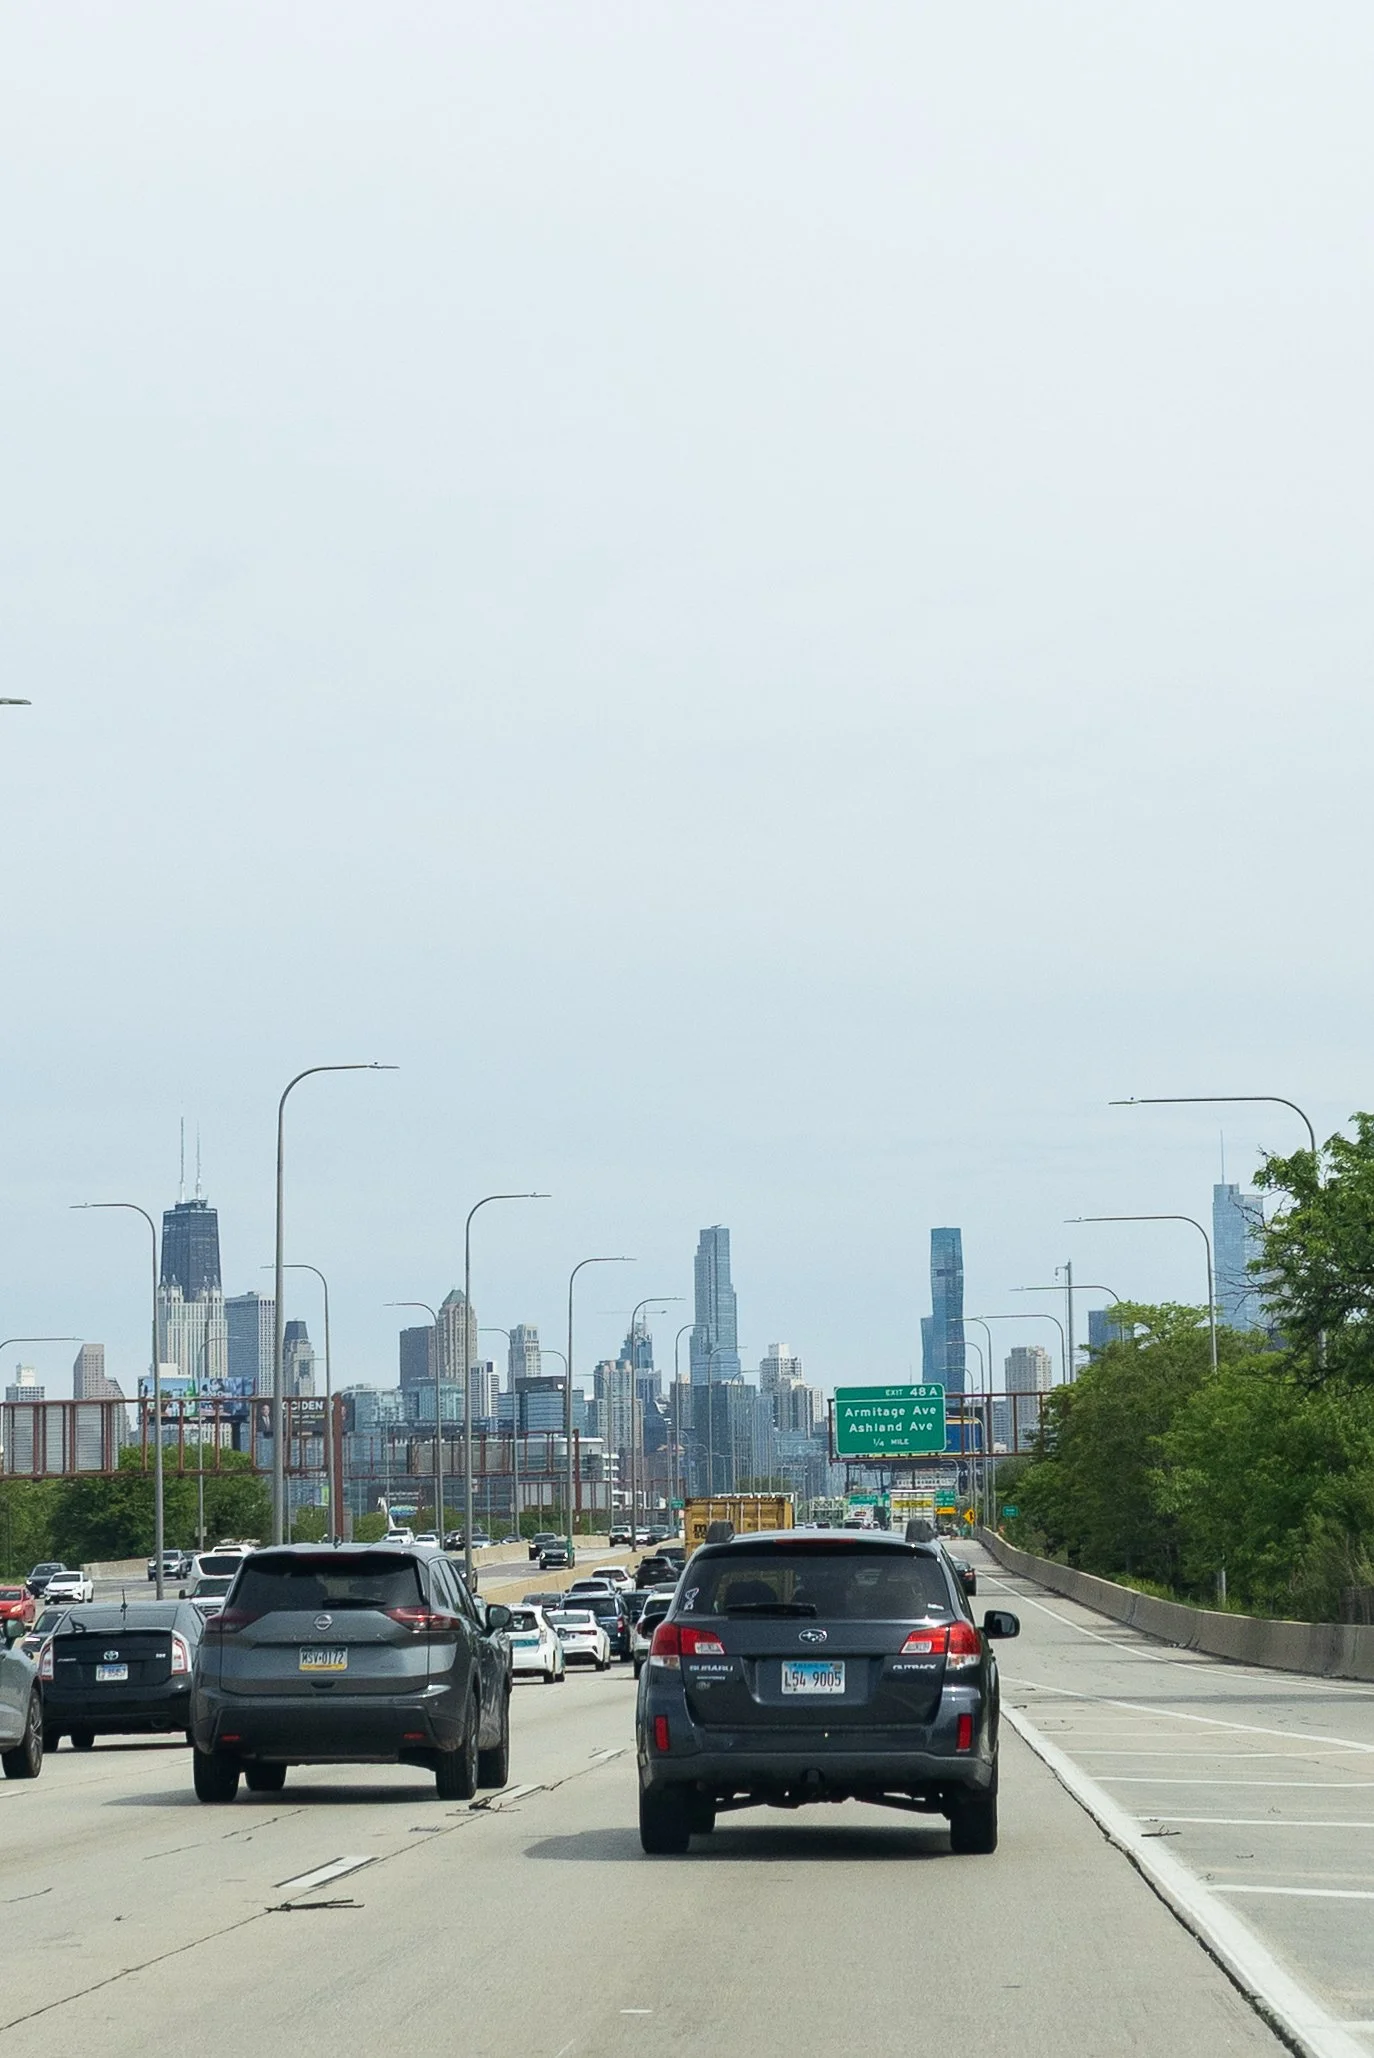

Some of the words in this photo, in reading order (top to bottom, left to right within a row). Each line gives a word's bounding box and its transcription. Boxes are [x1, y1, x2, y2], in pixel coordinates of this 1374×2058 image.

[844, 1407, 906, 1419] Armitage
[913, 1405, 937, 1415] Ave
[849, 1422, 903, 1433] Ashland
[909, 1421, 933, 1431] Ave
[890, 1438, 909, 1446] MILE
[784, 1671, 806, 1687] L54
[812, 1671, 841, 1687] 9005
